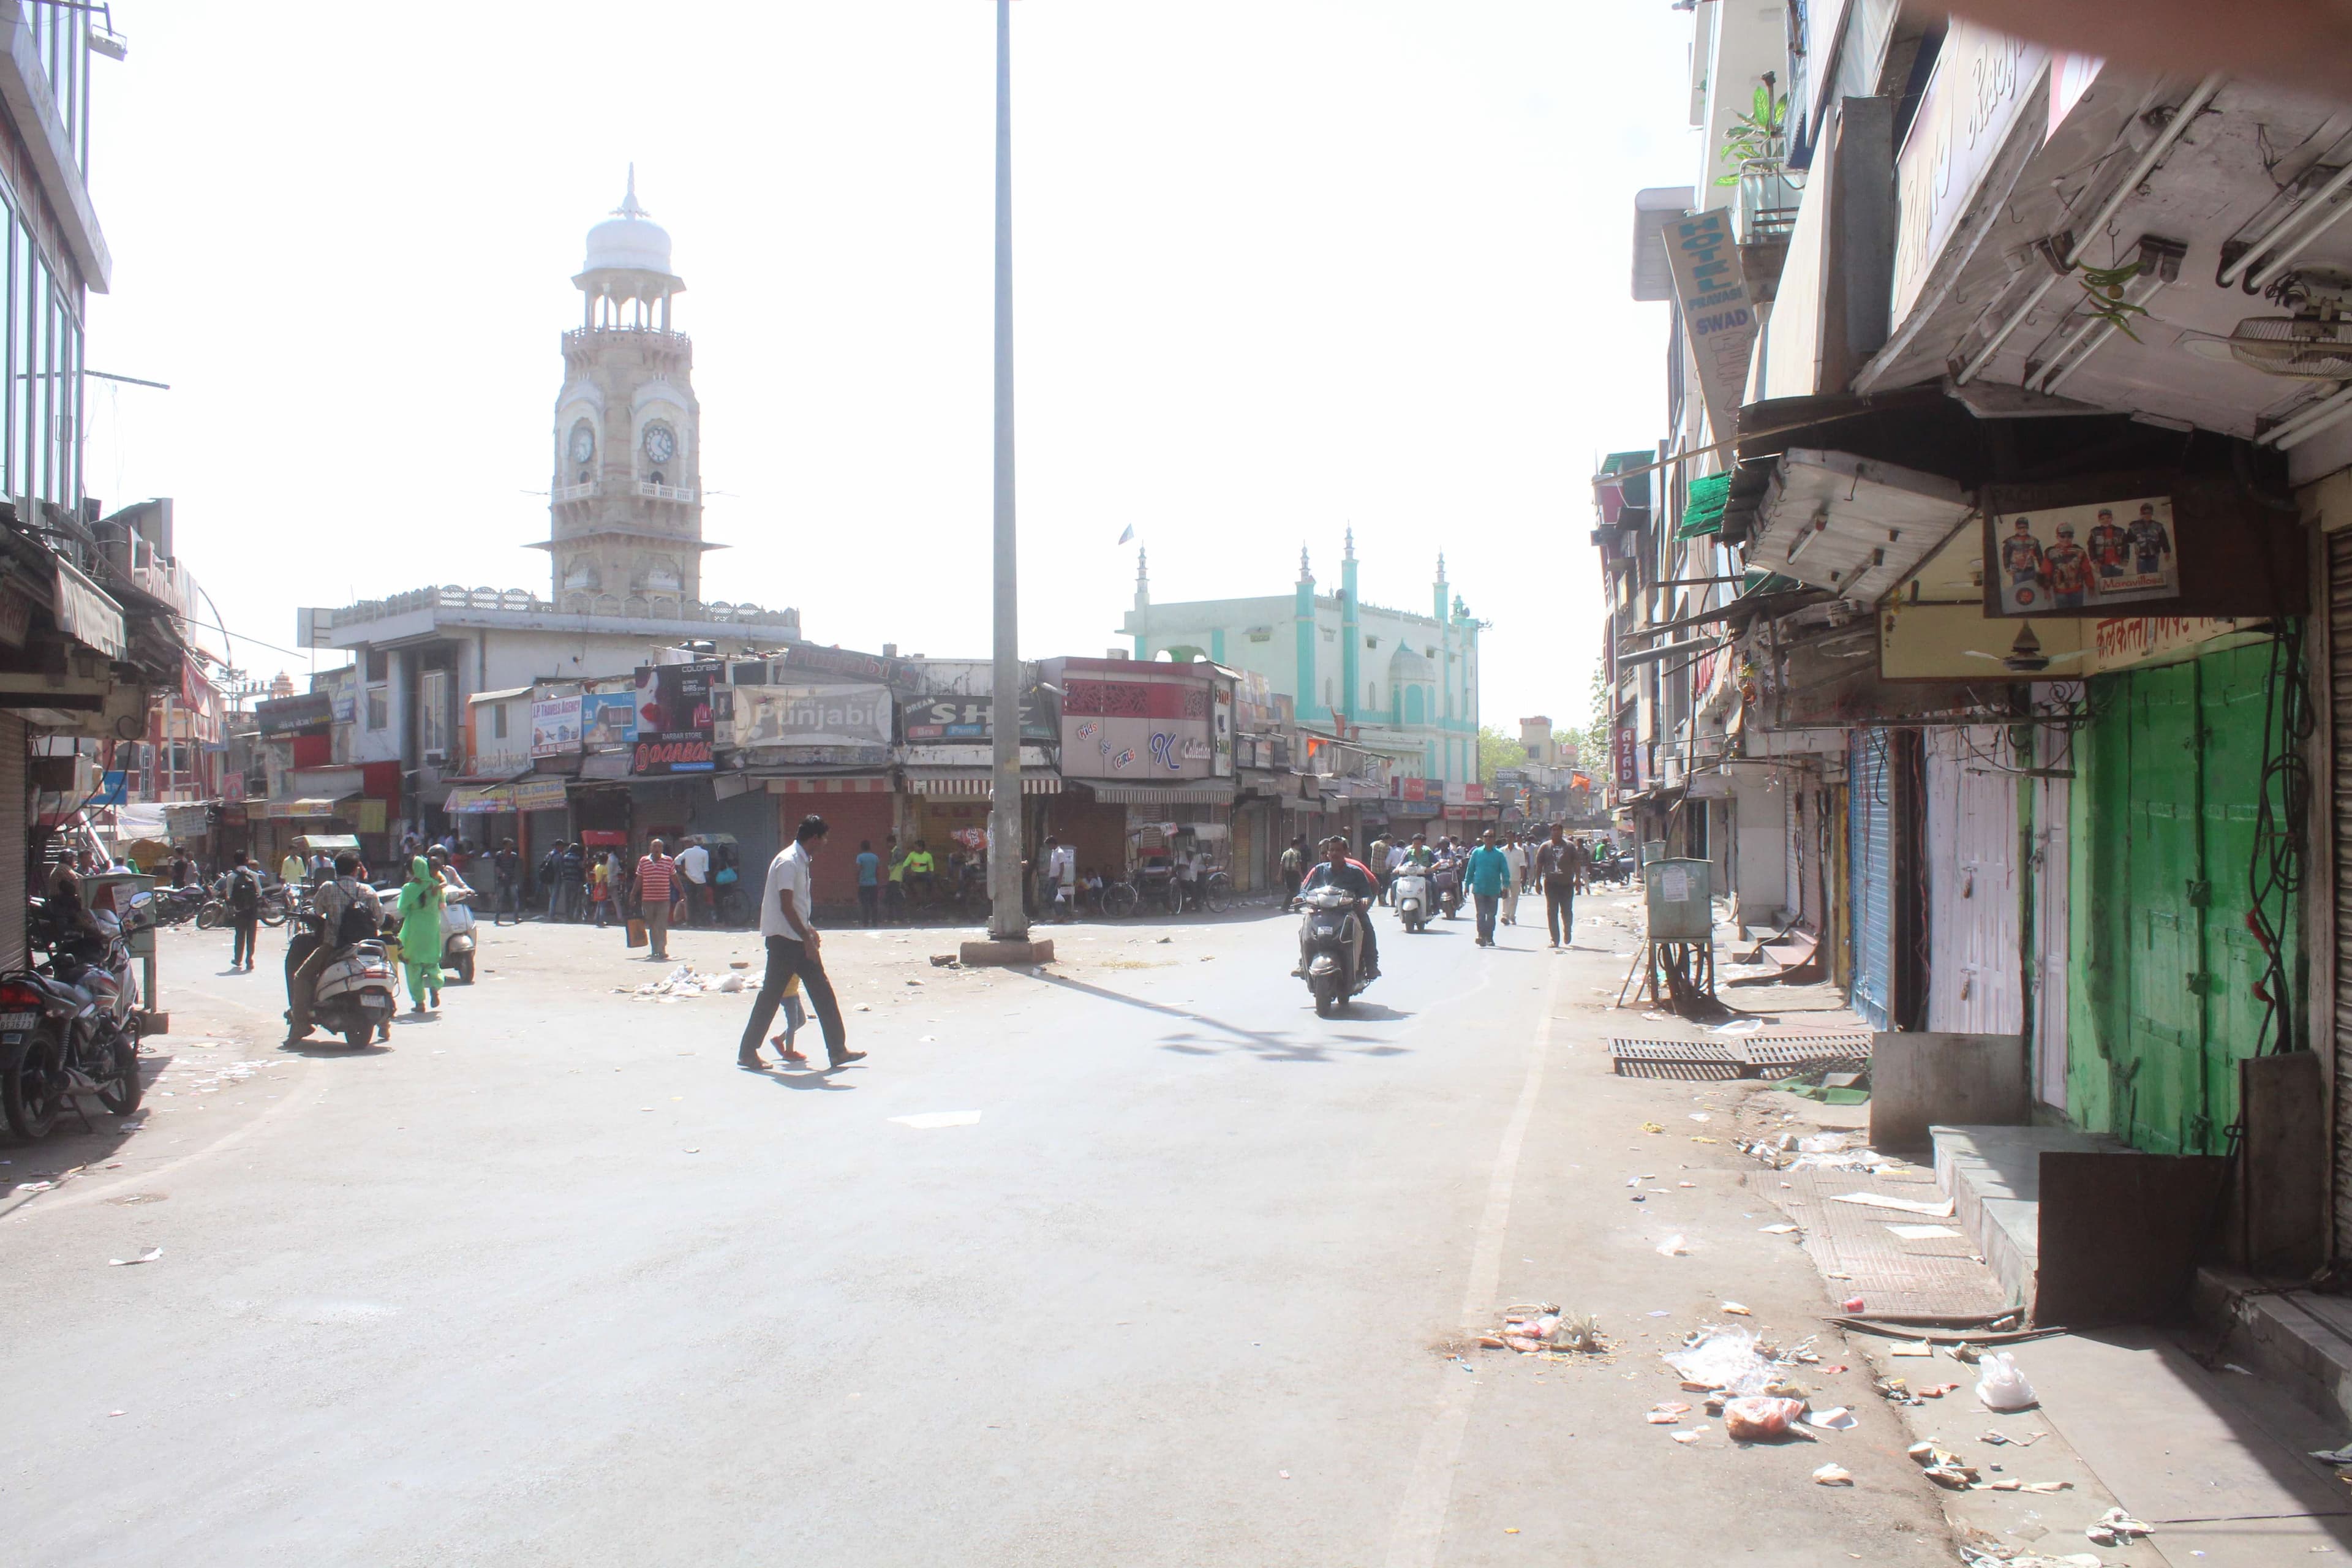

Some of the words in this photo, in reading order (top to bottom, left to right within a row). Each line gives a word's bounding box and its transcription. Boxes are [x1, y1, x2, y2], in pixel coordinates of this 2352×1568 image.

[1678, 216, 1732, 295] HOTEL
[1688, 287, 1743, 311] PRAVASI
[1696, 309, 1749, 336] SWAD
[788, 646, 892, 679] Punjabi
[756, 704, 873, 731] Punjabi
[905, 697, 936, 714] DREAM
[1078, 722, 1098, 740] Kids
[1100, 739, 1112, 755] &
[1114, 748, 1136, 770] GIRLS
[1150, 732, 1180, 771] K
[1621, 729, 1632, 780] AZAD
